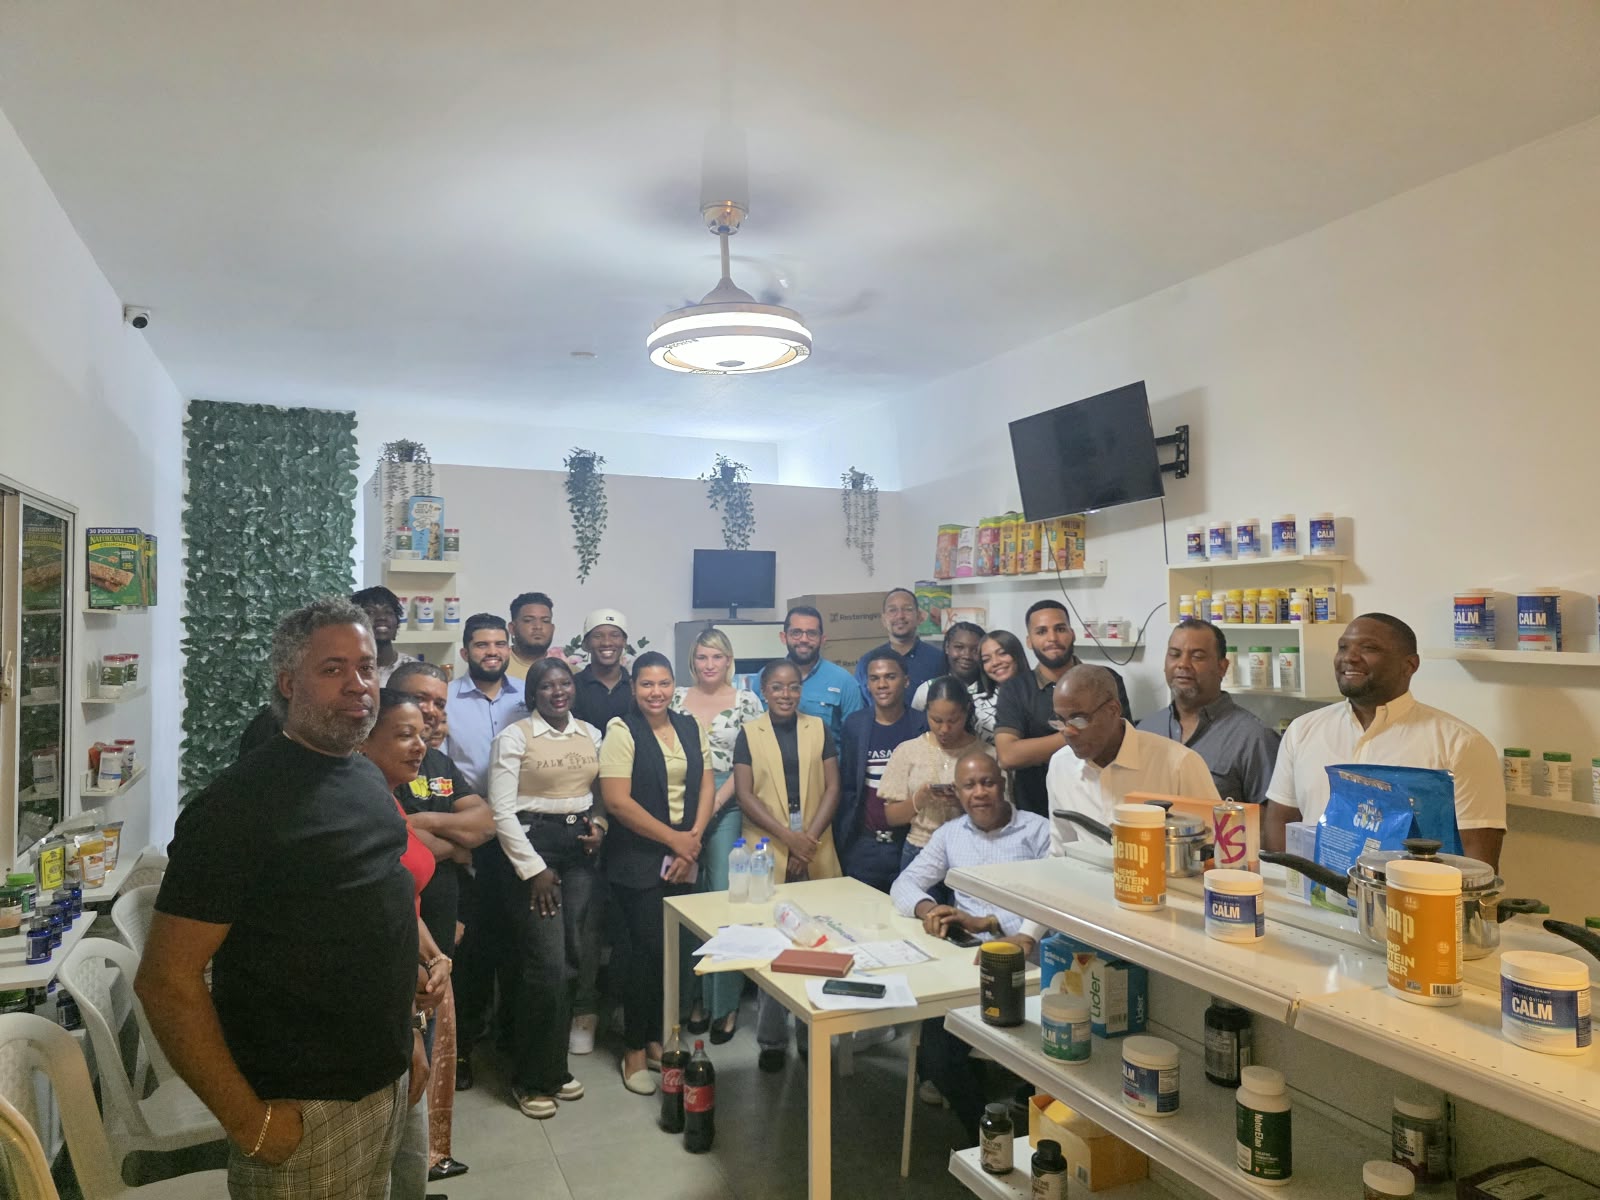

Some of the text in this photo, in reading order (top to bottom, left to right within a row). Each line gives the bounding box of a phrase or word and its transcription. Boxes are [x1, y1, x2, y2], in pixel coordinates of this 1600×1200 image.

[90, 534, 135, 545] NATURE VALLEY
[1519, 613, 1547, 625] CALM
[536, 759, 564, 769] PALM
[1213, 813, 1247, 864] XS
[1117, 867, 1138, 877] HEMP
[1212, 903, 1240, 919] CALM
[1090, 971, 1101, 1018] Lider
[1511, 996, 1553, 1021] CALM
